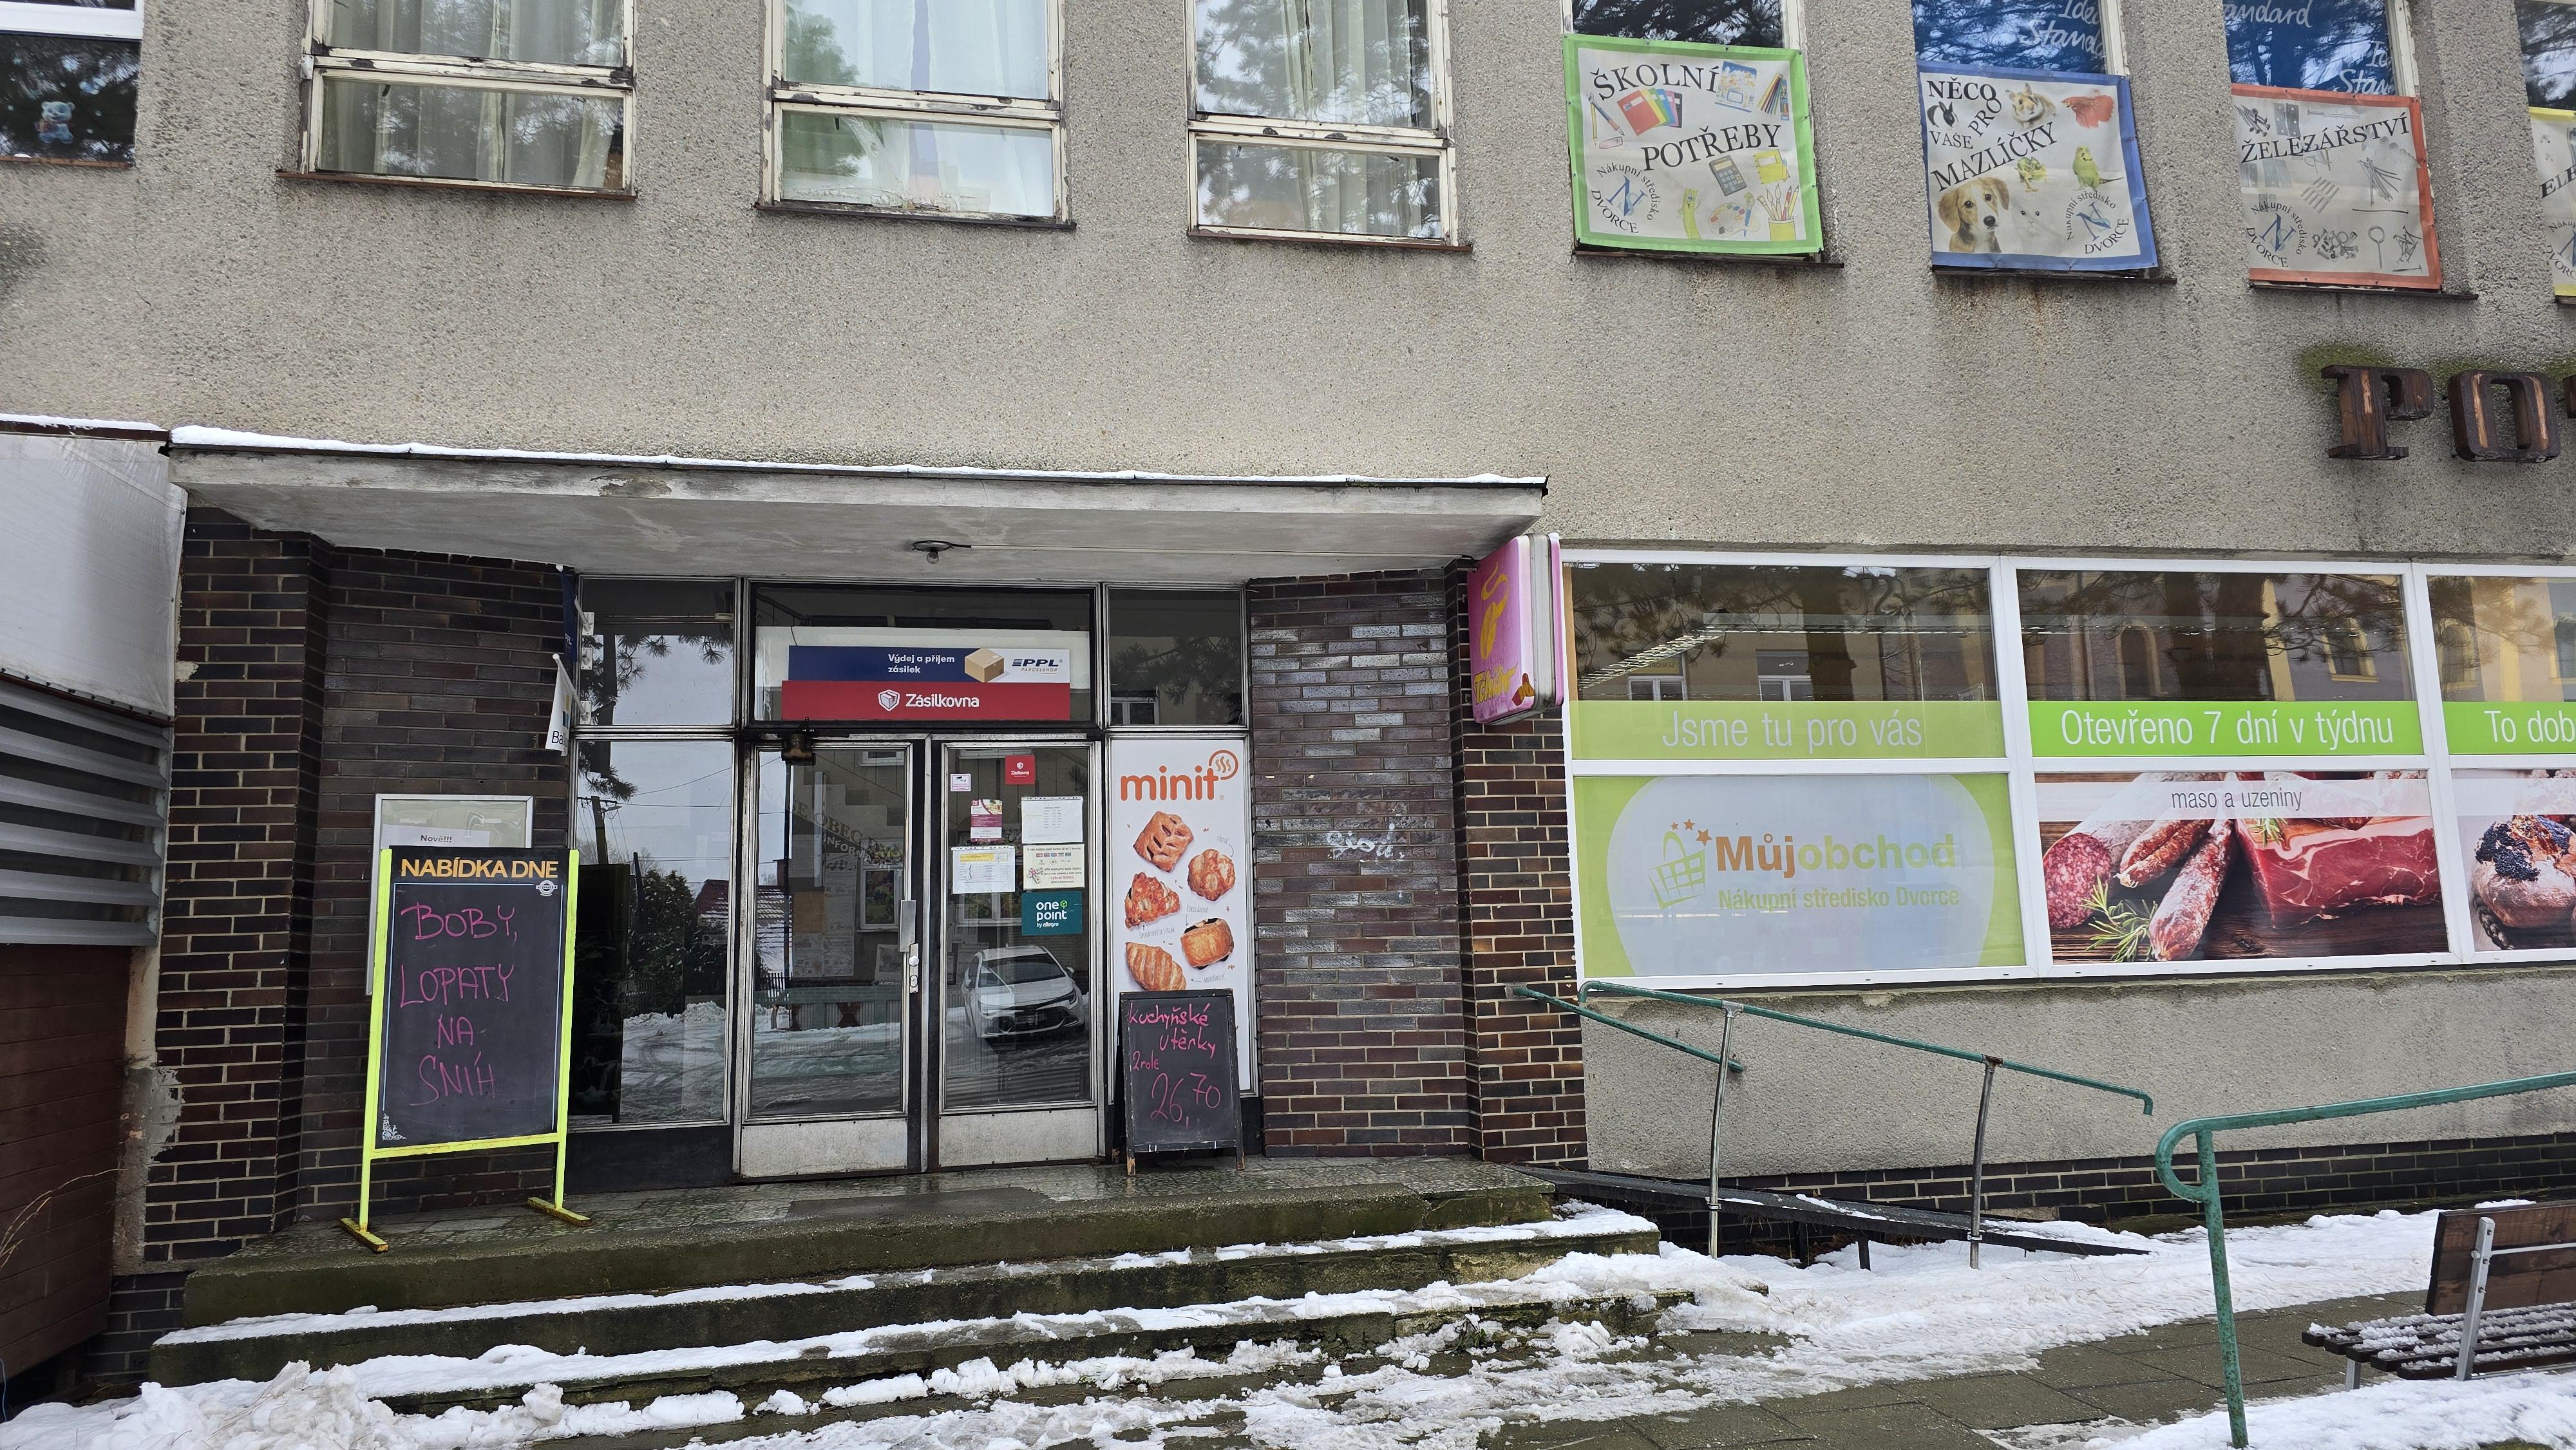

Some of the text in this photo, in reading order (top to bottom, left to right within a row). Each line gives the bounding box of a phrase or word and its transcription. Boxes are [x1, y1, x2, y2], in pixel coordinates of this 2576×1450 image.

[1590, 63, 1719, 101] ŠKOLNÍ
[1926, 77, 1996, 101] NĚCO
[1968, 99, 2002, 138] PRO
[2240, 112, 2410, 164] ŽELEZÁŘSTVÍ
[1641, 123, 1781, 171] POTŘEBY
[1929, 129, 1973, 149] VAŠE
[1931, 122, 2057, 193] MAZLÍČKY
[1596, 162, 1661, 221] Nákupní středisko
[1591, 189, 1639, 234] DVORCE
[2066, 190, 2117, 241] Nákupní středisko
[2251, 200, 2307, 256] Nákupní středisko
[2084, 218, 2130, 255] DVORCE
[2246, 226, 2289, 268] DVORCE
[2321, 364, 2576, 464] PO
[887, 665, 921, 673] zásilek
[888, 654, 914, 664] Výdej
[925, 654, 955, 664] příjem
[905, 693, 980, 708] Zásilkovna
[1662, 710, 1922, 753] Jsme tu pro vás
[2061, 708, 2394, 751] Otevřeno 7 dní v týdnu
[2484, 710, 2516, 742] To
[1121, 765, 1219, 801] minit
[2172, 788, 2302, 812] maso a uzeniny
[401, 857, 559, 878] NABÍDKA DNE
[1716, 833, 1956, 878] Můjobchod
[1036, 901, 1059, 910] one
[1036, 910, 1067, 921] point
[1719, 886, 1959, 914] Nákupní středisko Dvorce
[401, 903, 519, 946] BOBY,
[401, 963, 515, 1008] LOPATY
[437, 1013, 474, 1049] NA
[409, 1051, 497, 1106] SNÍH
